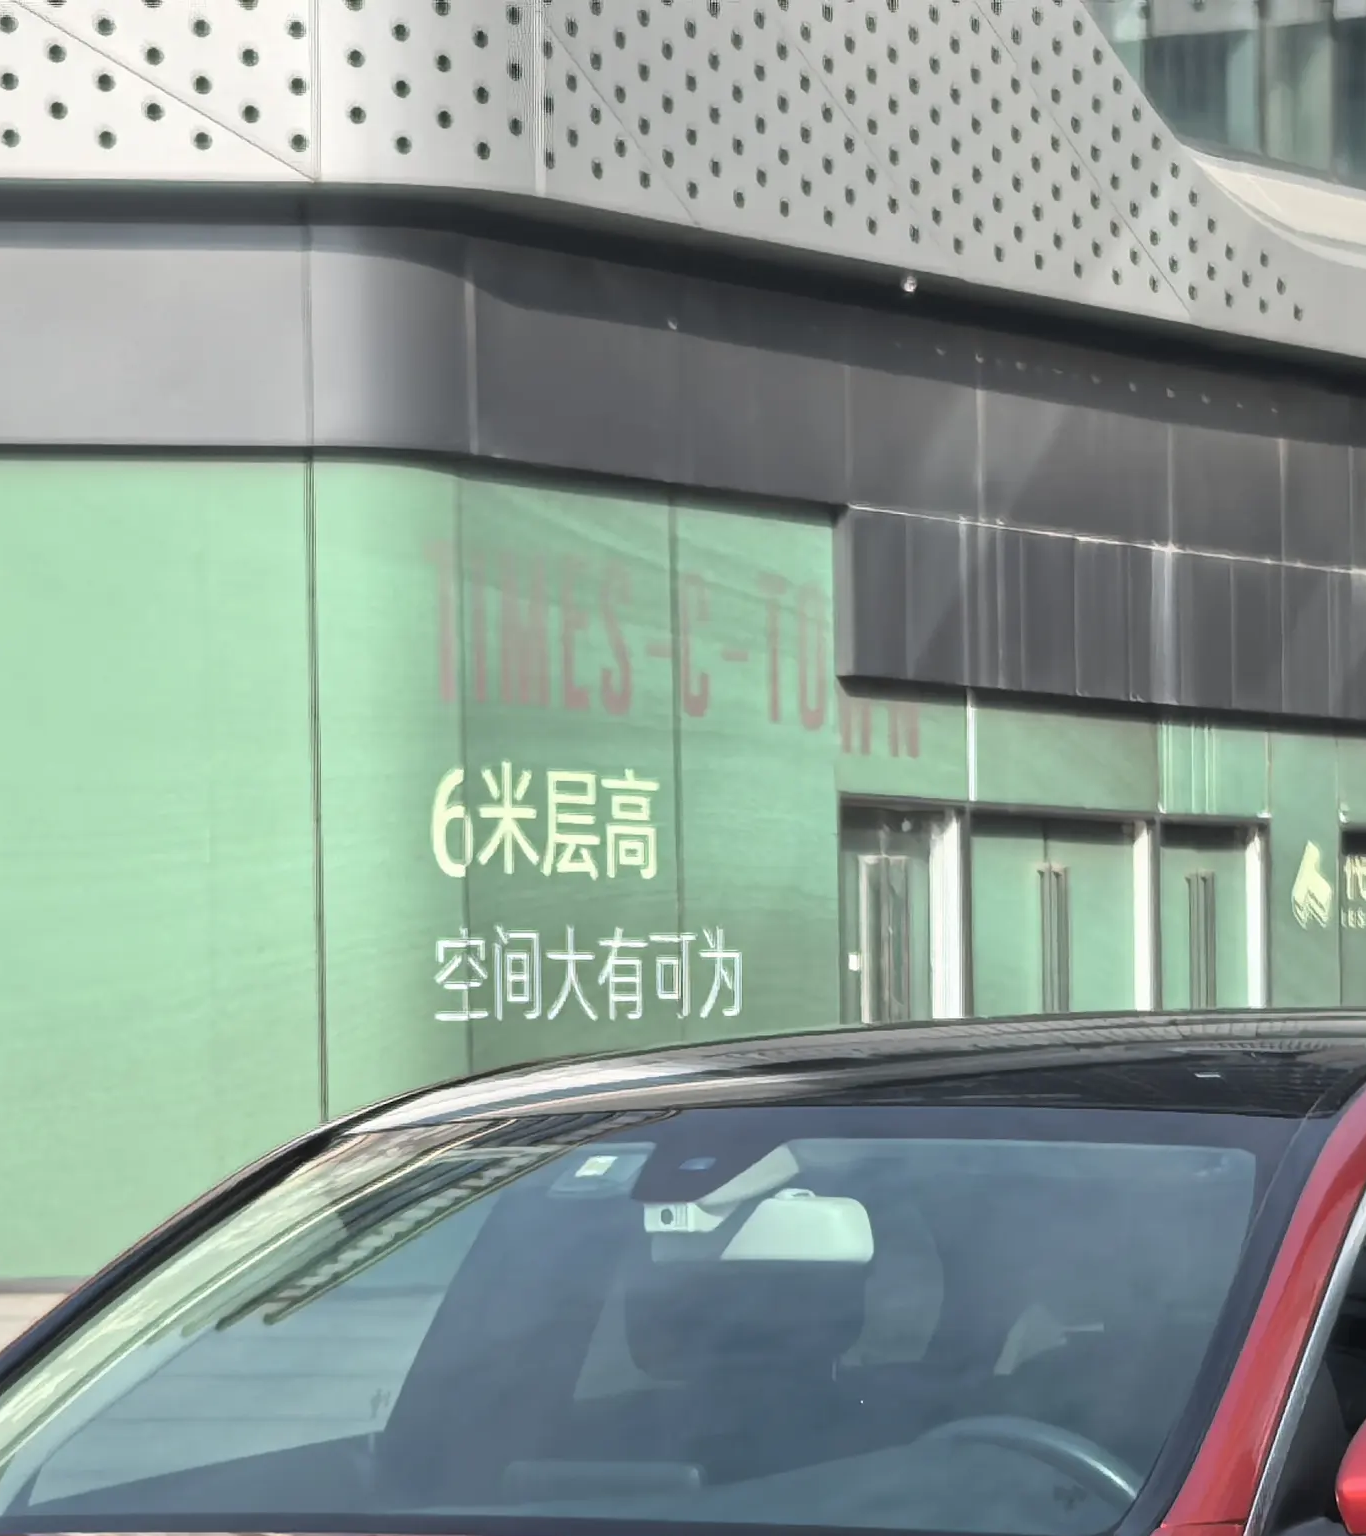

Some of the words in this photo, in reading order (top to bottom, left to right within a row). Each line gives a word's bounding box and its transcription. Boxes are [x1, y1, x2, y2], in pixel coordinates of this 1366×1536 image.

[431, 760, 660, 881] 6米层高
[434, 925, 743, 1022] 空间大有可为
